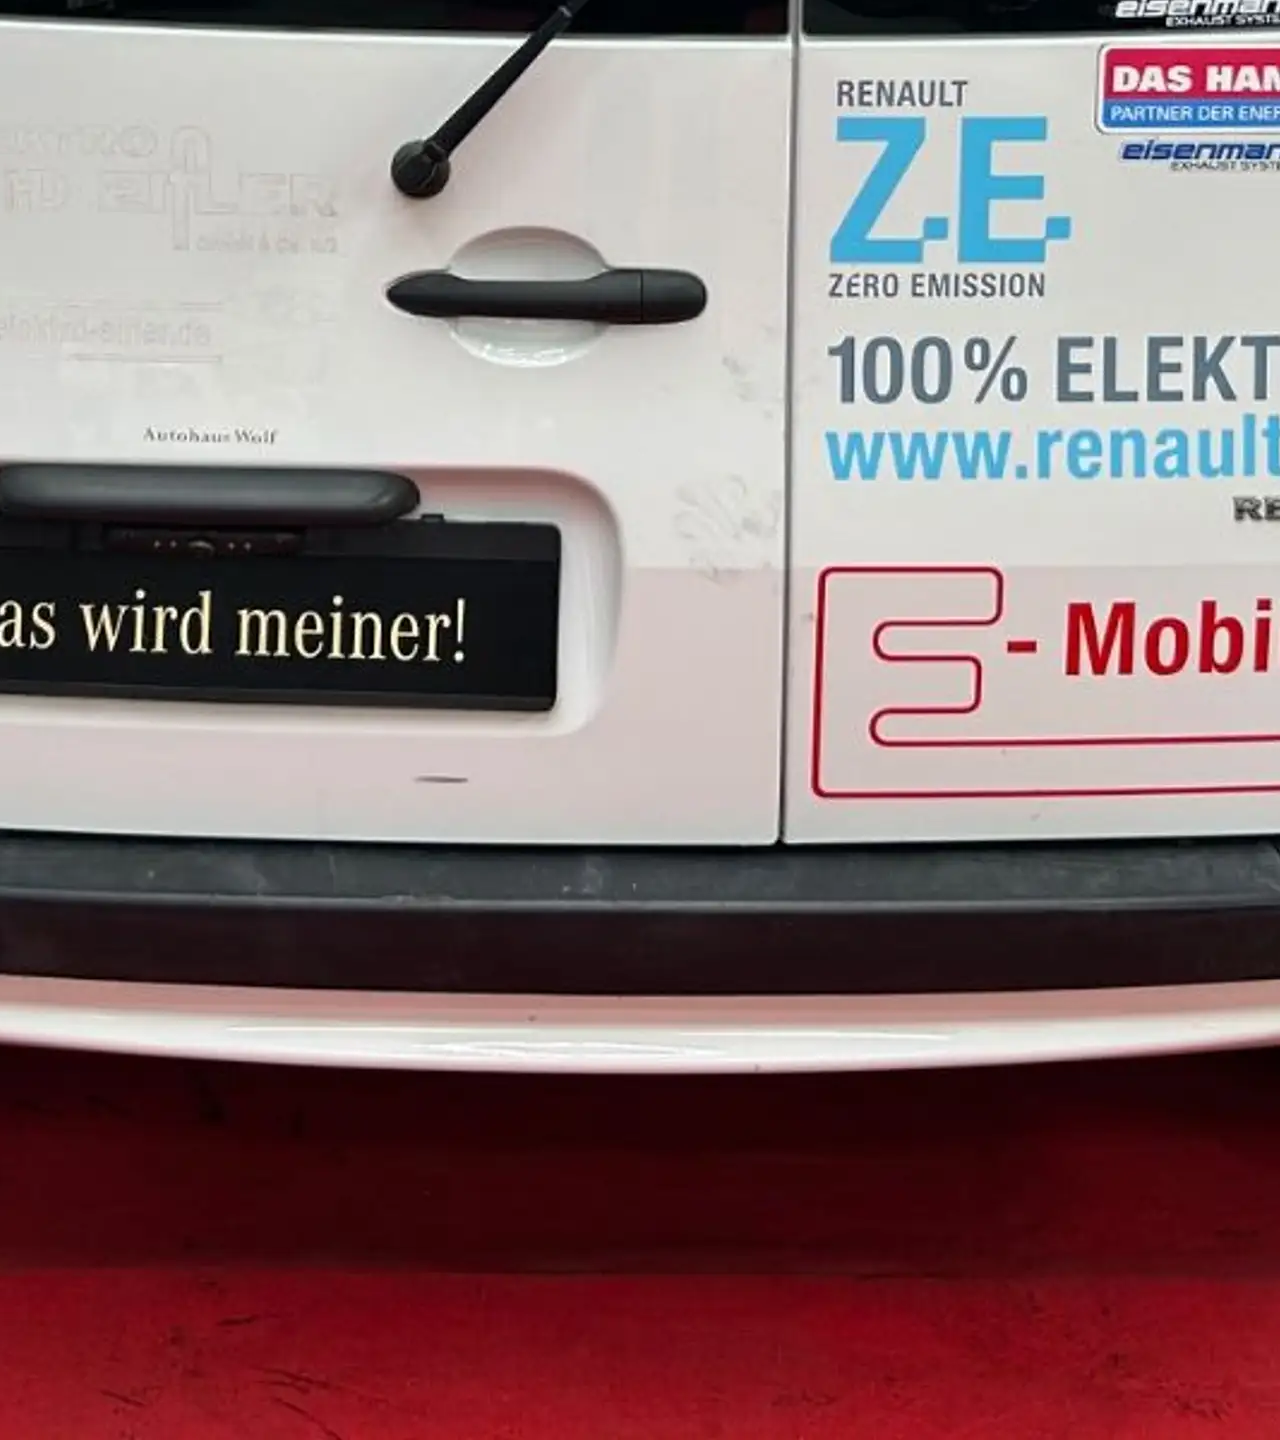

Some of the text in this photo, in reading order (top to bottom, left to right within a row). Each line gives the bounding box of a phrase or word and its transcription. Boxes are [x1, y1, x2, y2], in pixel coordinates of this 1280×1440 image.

[1166, 15, 1231, 28] EXHAUST
[1113, 65, 1193, 93] DAS
[836, 81, 968, 107] RENAULT
[1111, 107, 1193, 122] PARTNER
[1199, 105, 1234, 121] DER
[1170, 162, 1235, 174] EXHAUST
[828, 272, 1046, 298] ZERO EMISSION
[828, 335, 1028, 405] 100%
[143, 425, 279, 445] Autohaus Wolf
[79, 588, 212, 656] wird
[235, 594, 468, 664] meiner!
